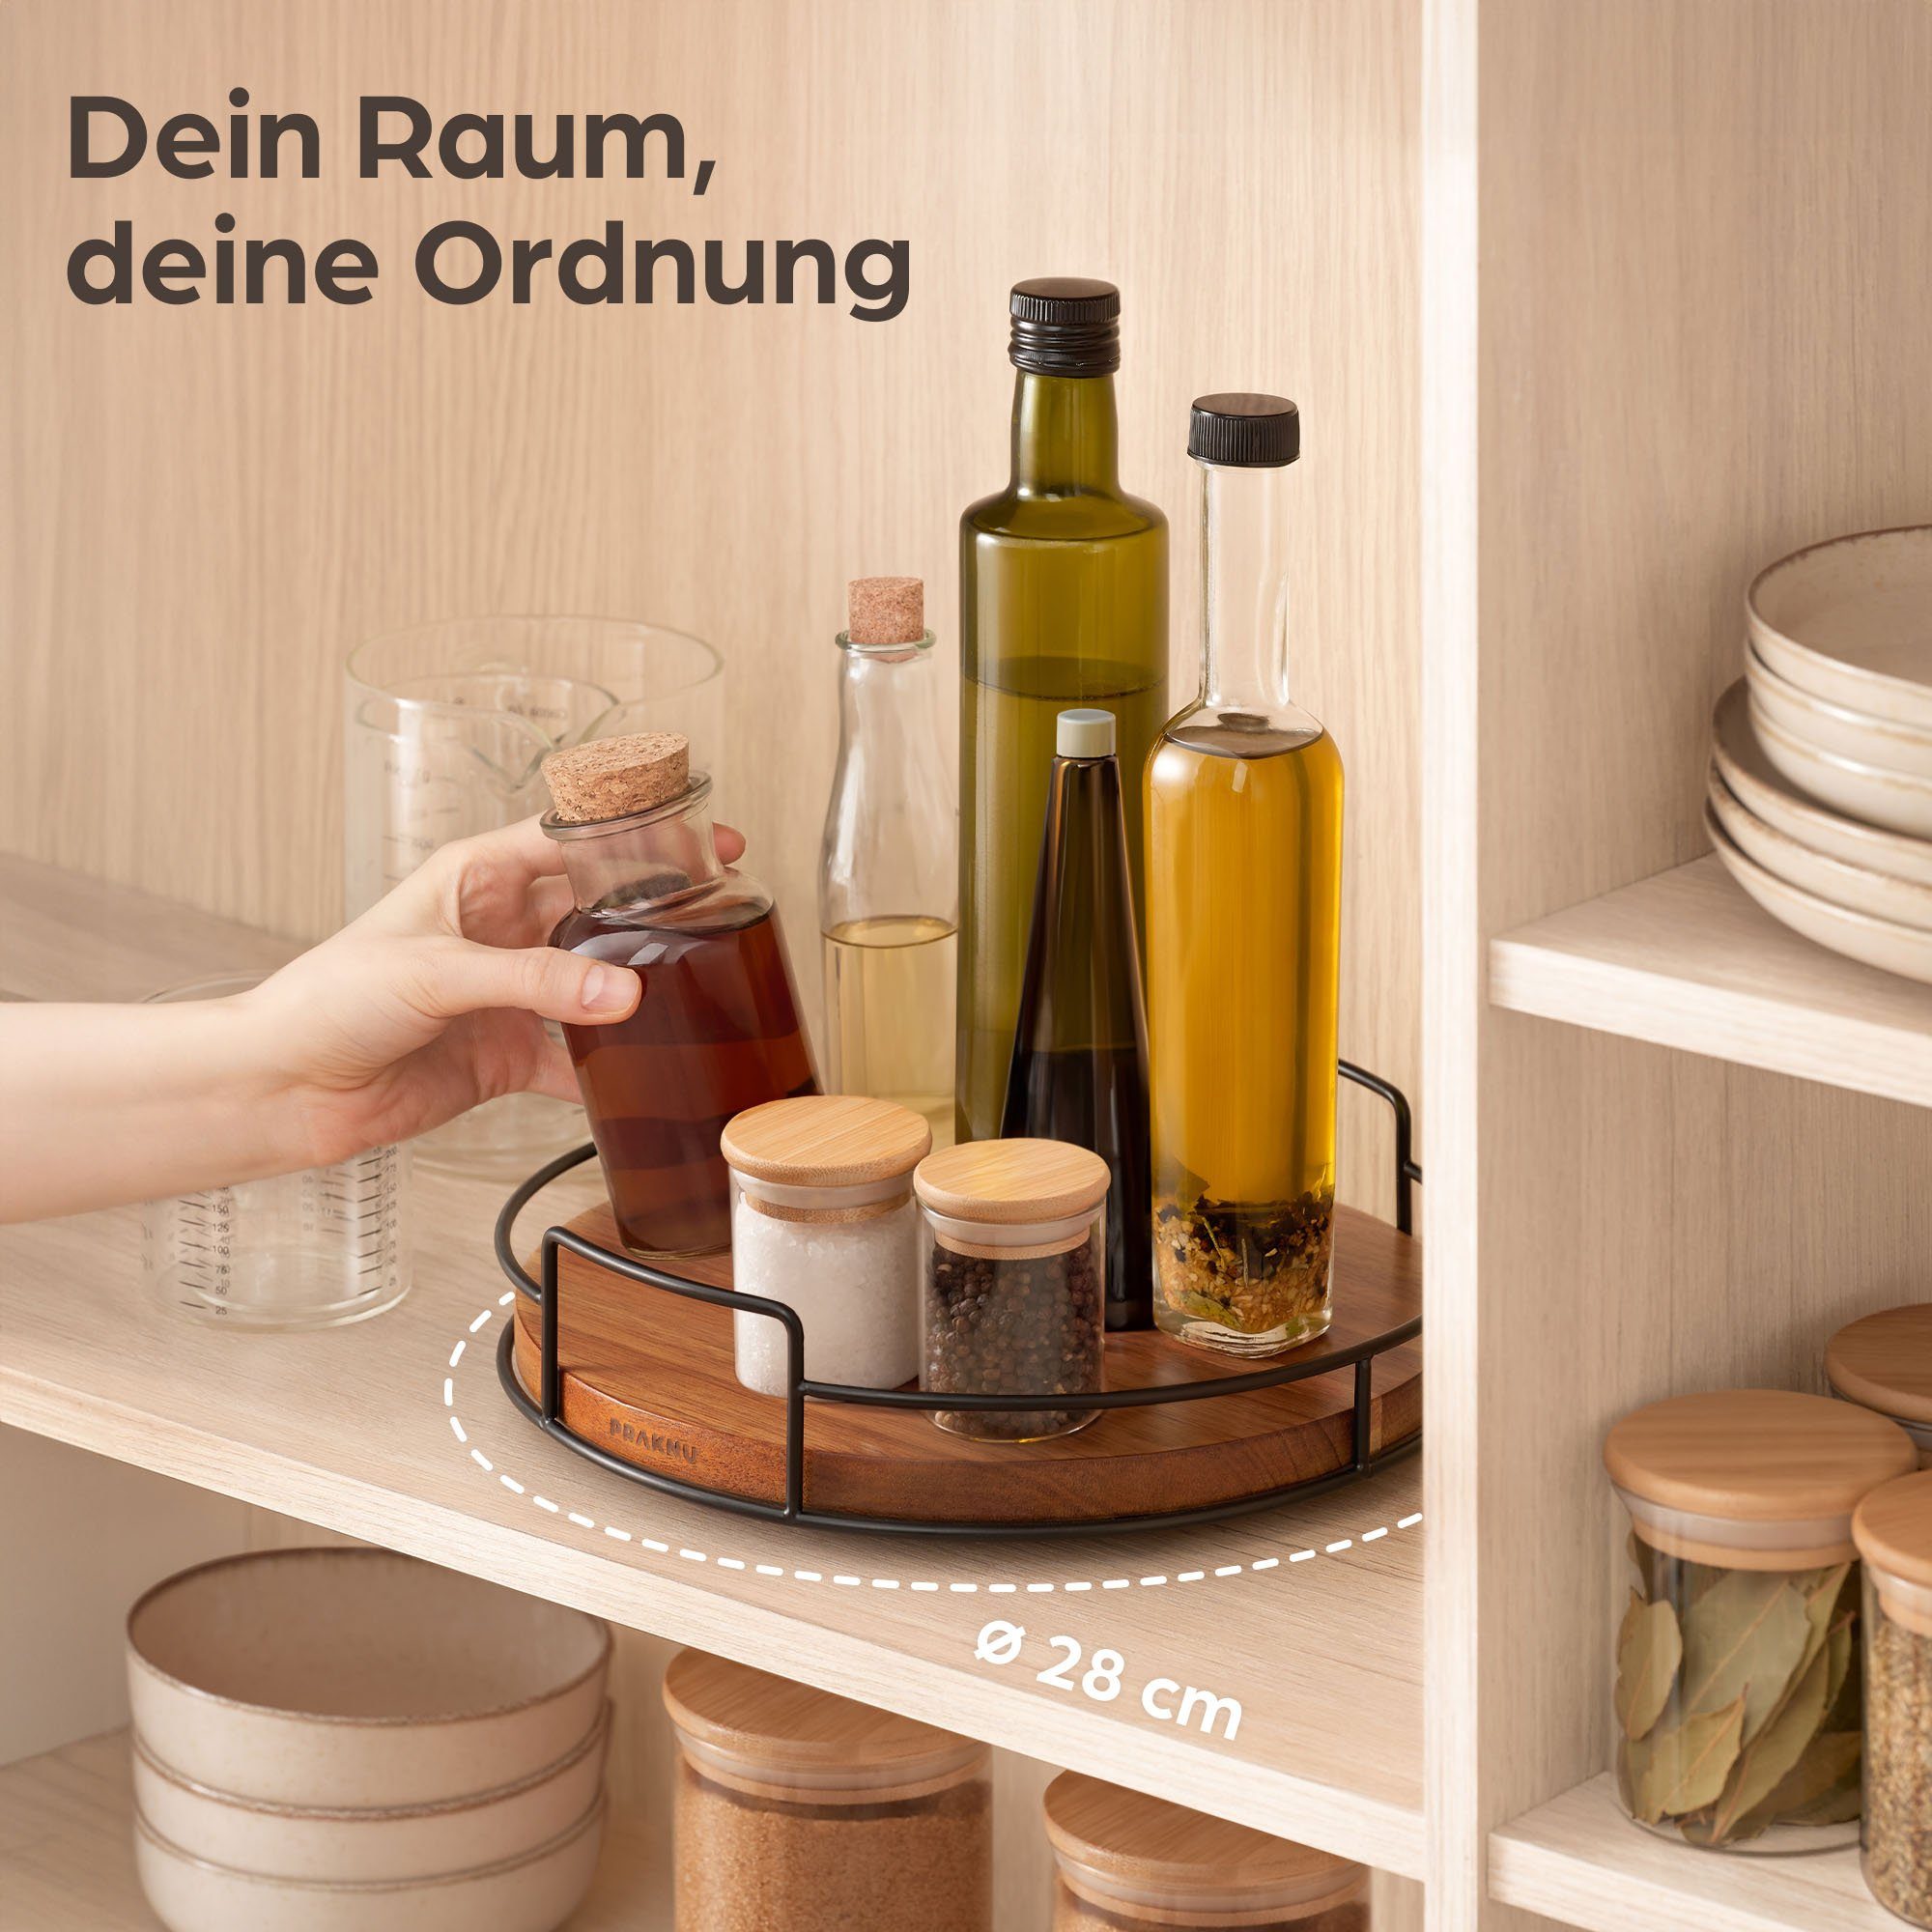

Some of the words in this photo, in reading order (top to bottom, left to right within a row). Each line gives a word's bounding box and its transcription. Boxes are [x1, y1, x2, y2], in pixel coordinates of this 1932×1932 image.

[213, 1205, 229, 1214] 150
[213, 1245, 229, 1255] 100
[215, 1285, 227, 1295] 50
[215, 1305, 227, 1316] 25
[610, 1417, 697, 1463] PRAKNU
